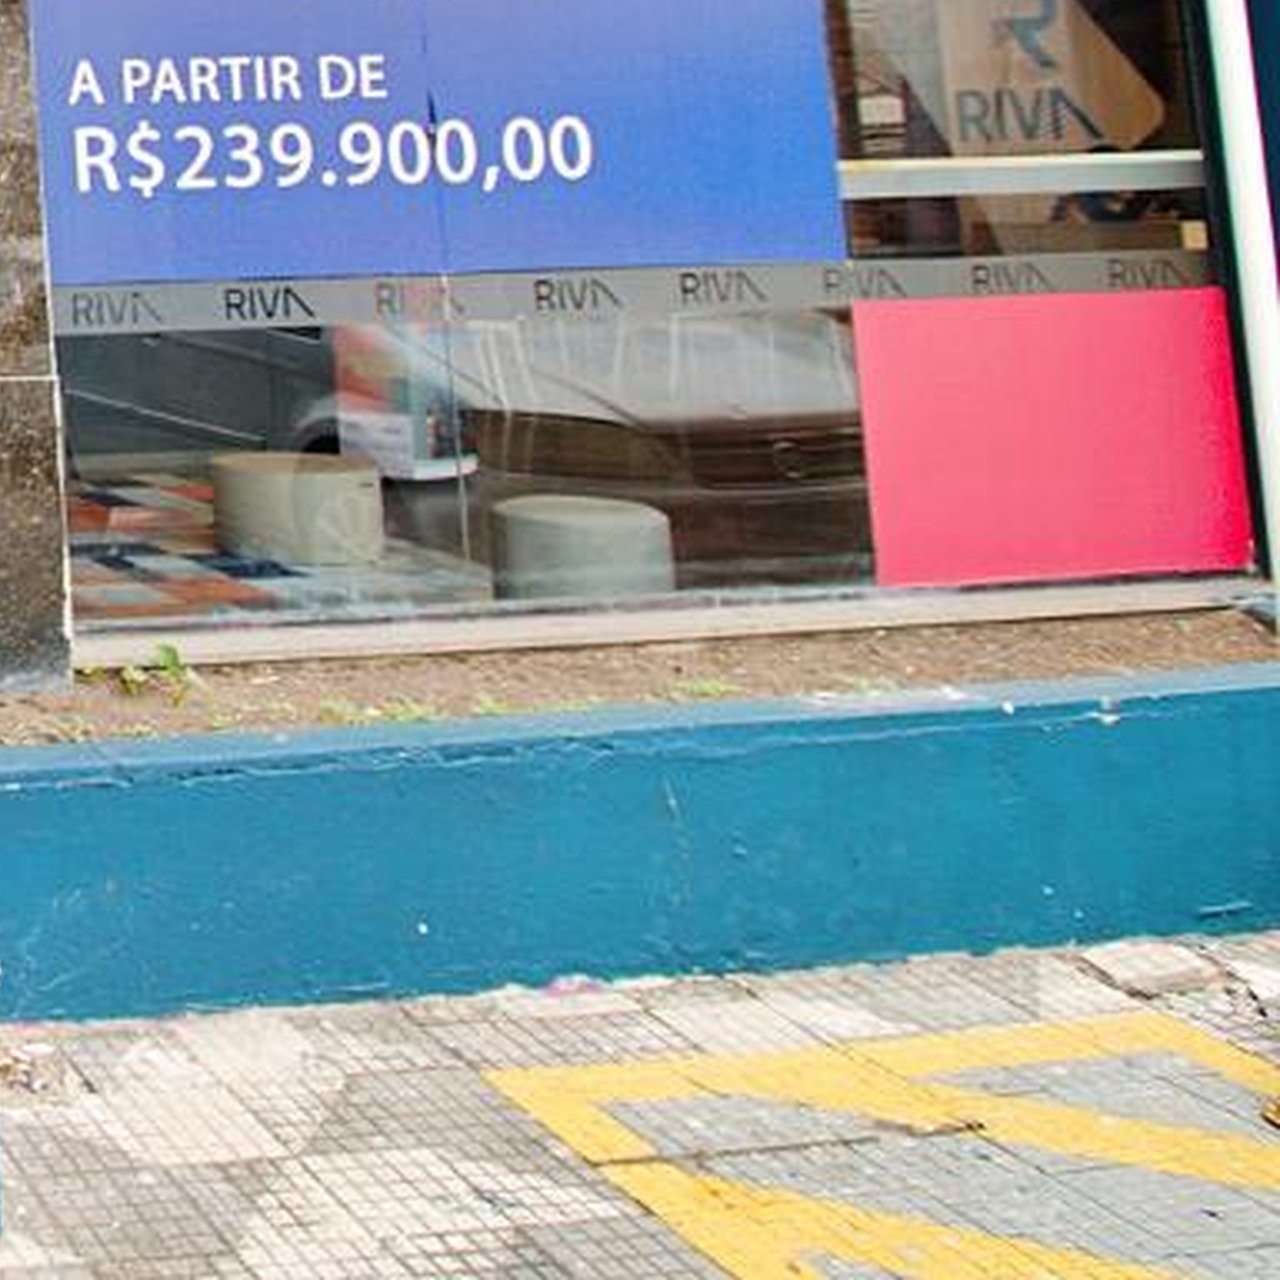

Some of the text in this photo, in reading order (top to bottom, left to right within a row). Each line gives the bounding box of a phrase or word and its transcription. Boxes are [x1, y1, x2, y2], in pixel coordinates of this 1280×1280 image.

[67, 54, 388, 106] A PARTIR DE
[72, 116, 593, 198] R$239.900,00
